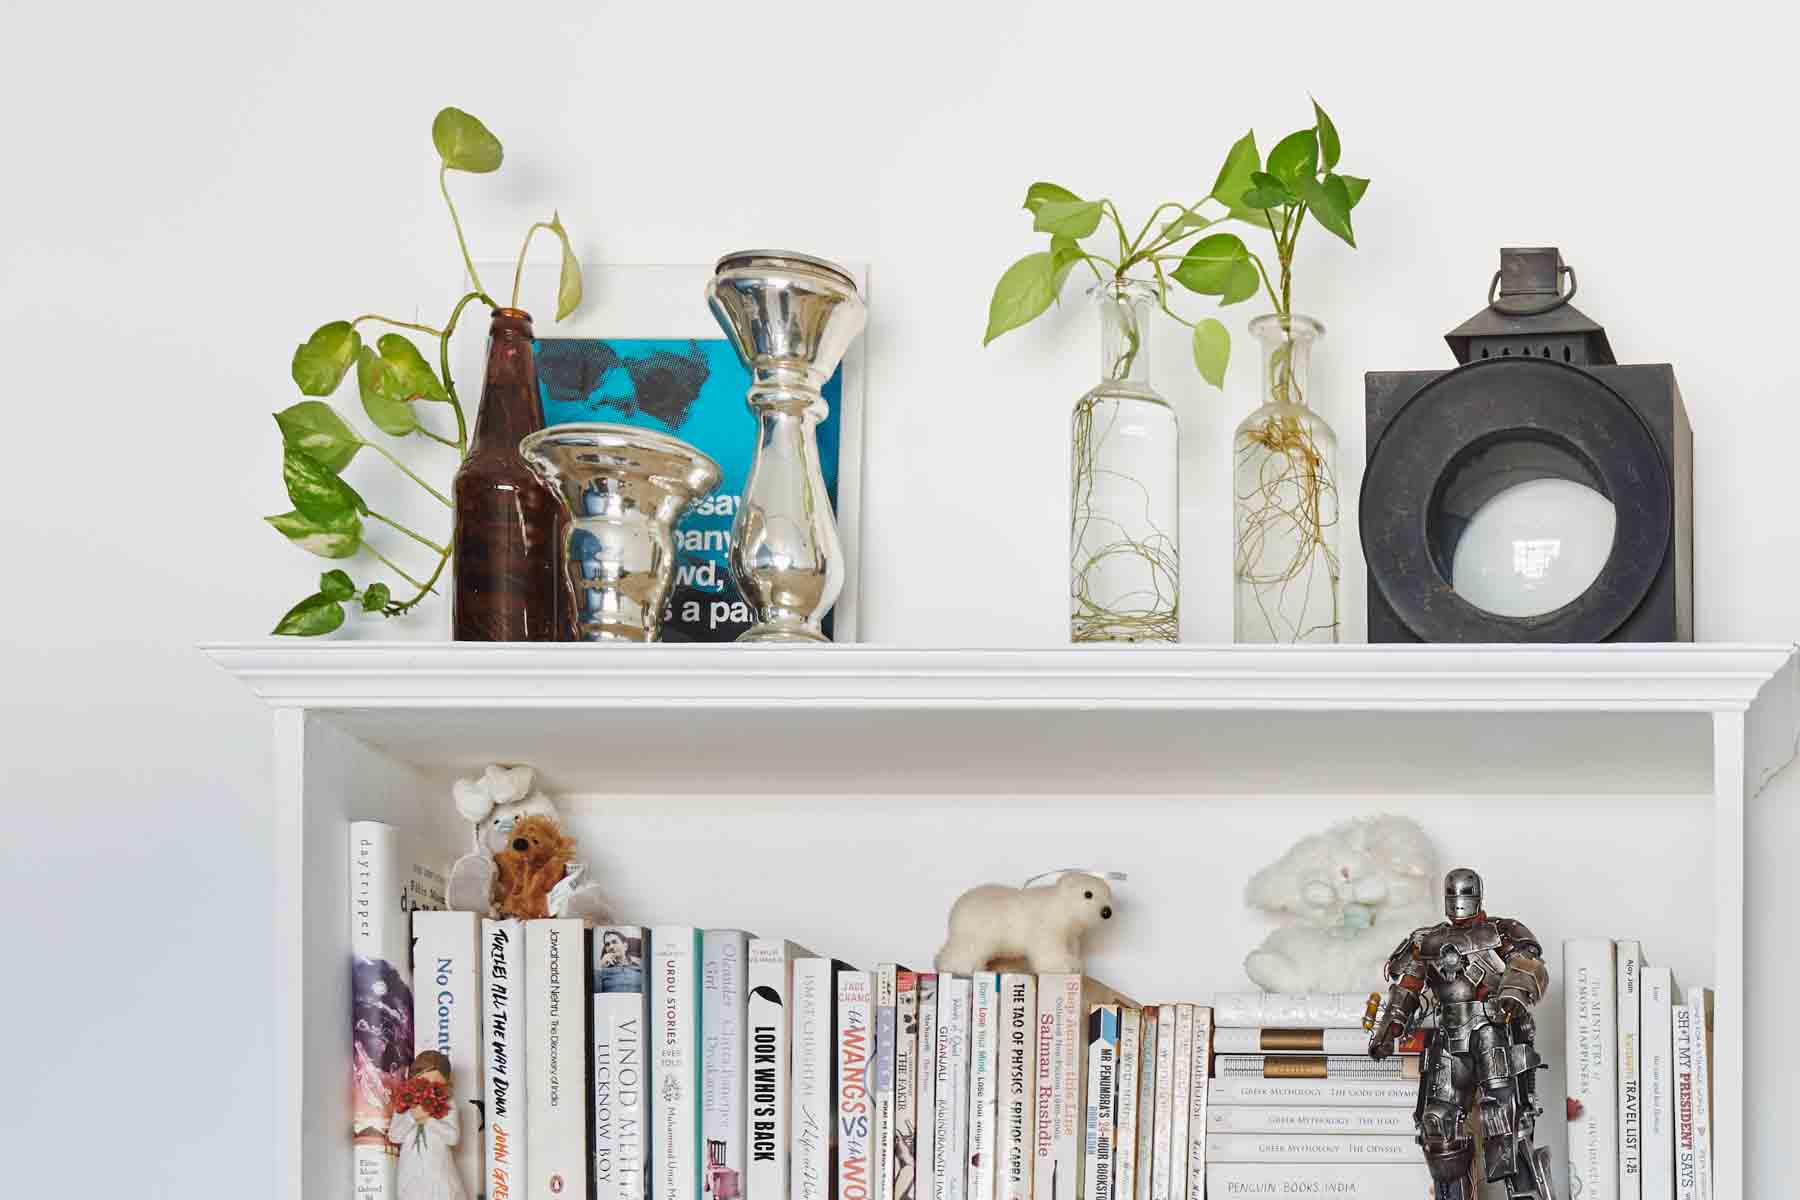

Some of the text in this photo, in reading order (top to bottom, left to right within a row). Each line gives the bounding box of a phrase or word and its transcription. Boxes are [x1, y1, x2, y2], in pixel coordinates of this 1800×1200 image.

[357, 839, 374, 937] daytripper
[491, 929, 509, 1118] TURTLES ALL THE WAY DOWN
[618, 1020, 638, 1106] VINOD
[1011, 983, 1025, 1095] THE TAO OF PHYSICS
[754, 1026, 775, 1161] LOOK WHO'S BACK
[842, 1027, 866, 1113] WANGS
[1038, 1014, 1054, 1158] Salman Rushdie
[492, 1123, 509, 1163] JOHN
[842, 1116, 868, 1138] VS
[1227, 1182, 1357, 1193] PENGUIN BOOKS INDIA
